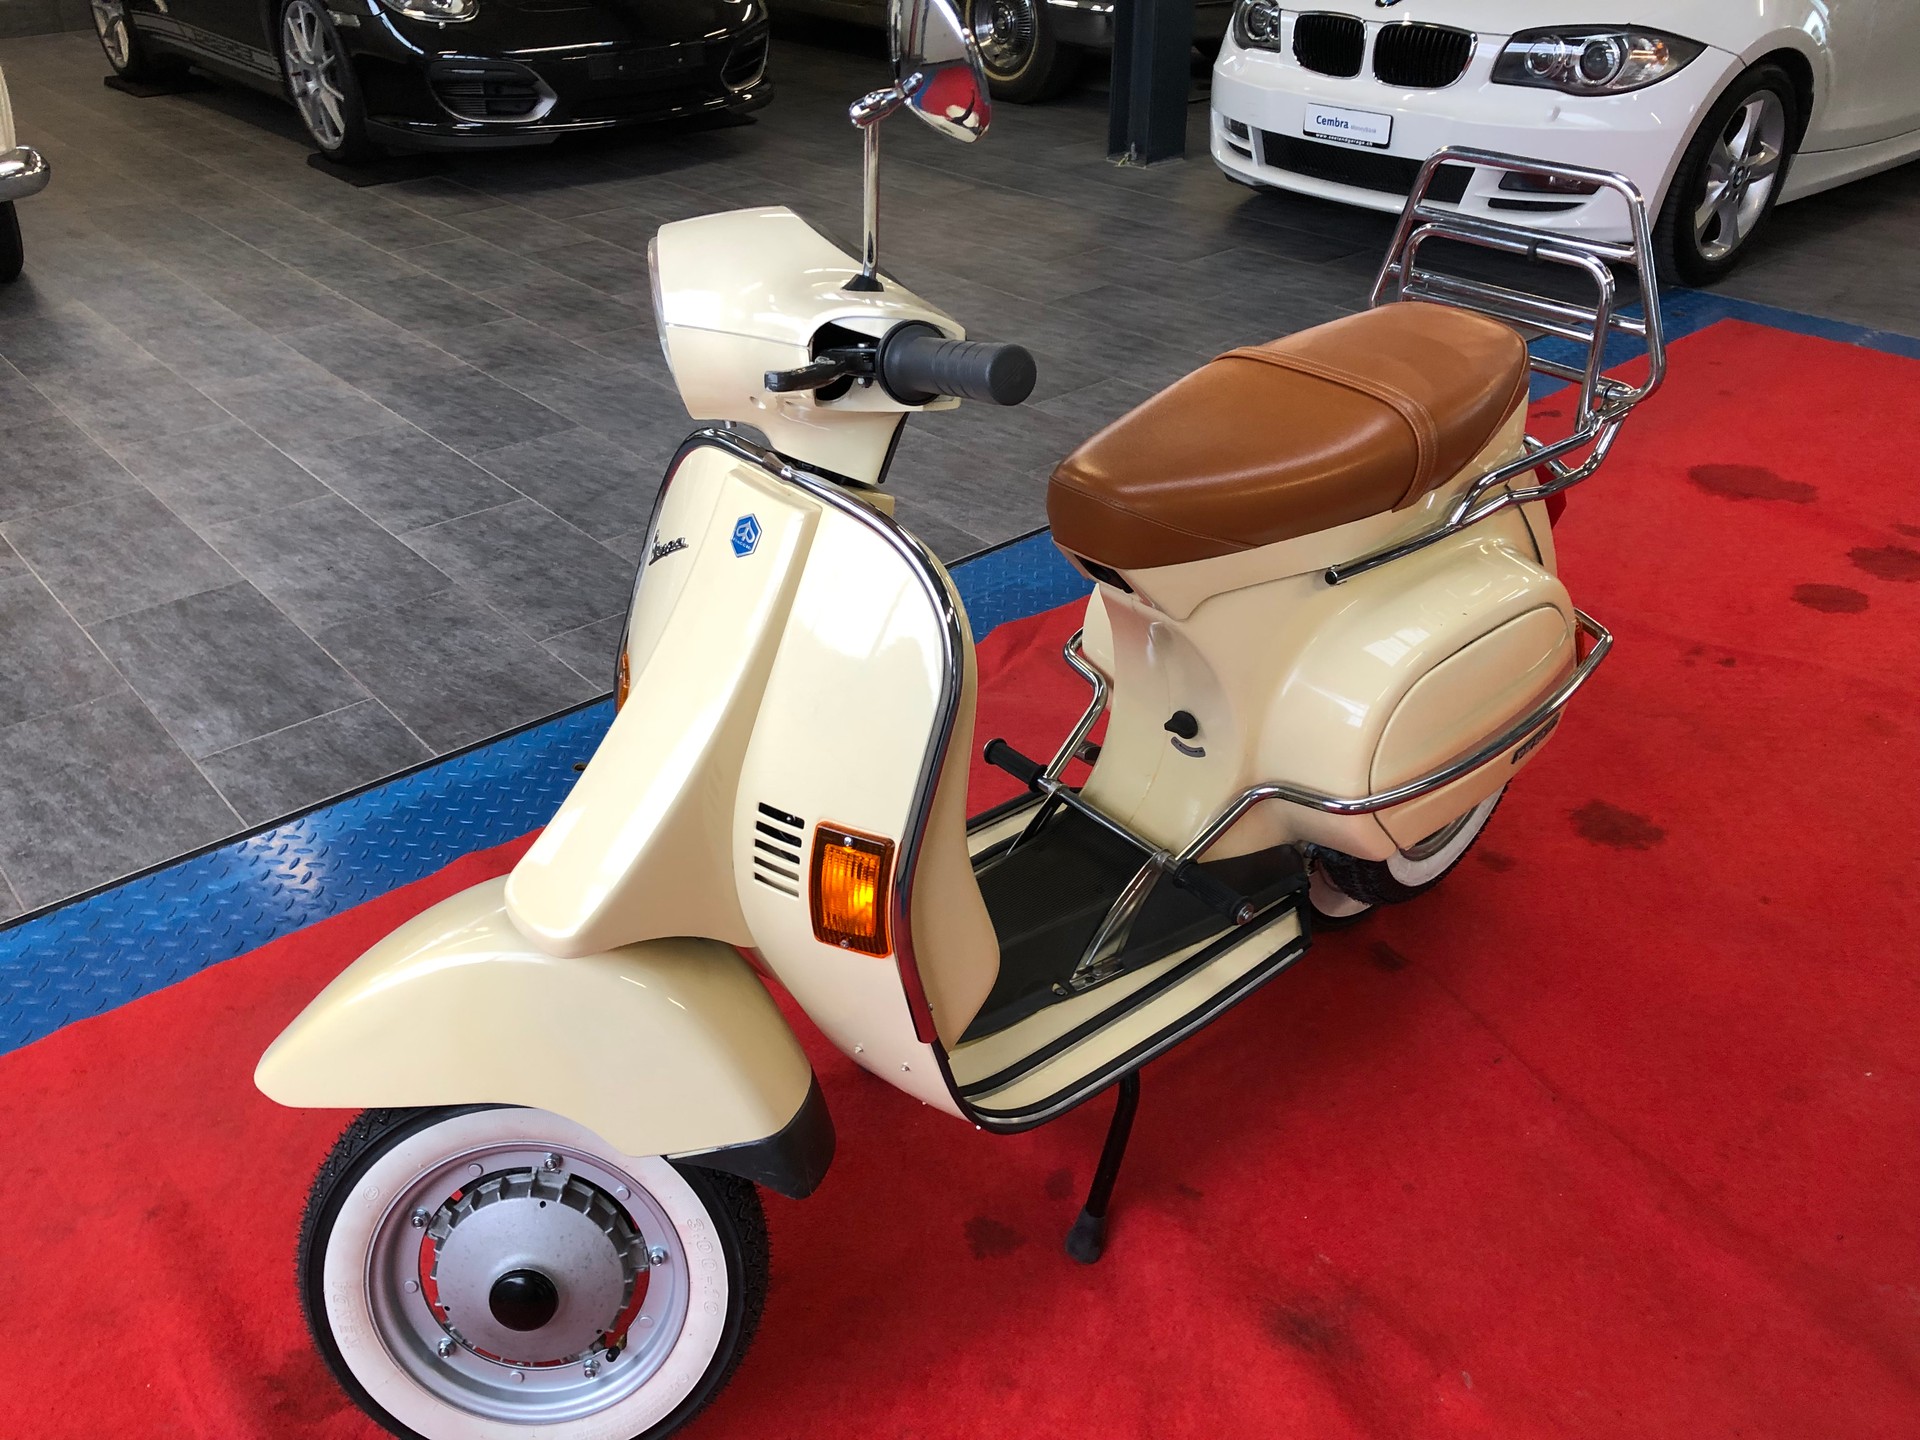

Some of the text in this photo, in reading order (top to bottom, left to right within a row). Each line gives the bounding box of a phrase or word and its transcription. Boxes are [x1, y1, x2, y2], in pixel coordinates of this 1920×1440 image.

[1315, 115, 1349, 129] Cembra
[649, 529, 689, 566] Vespa
[332, 1281, 362, 1352] KENDA
